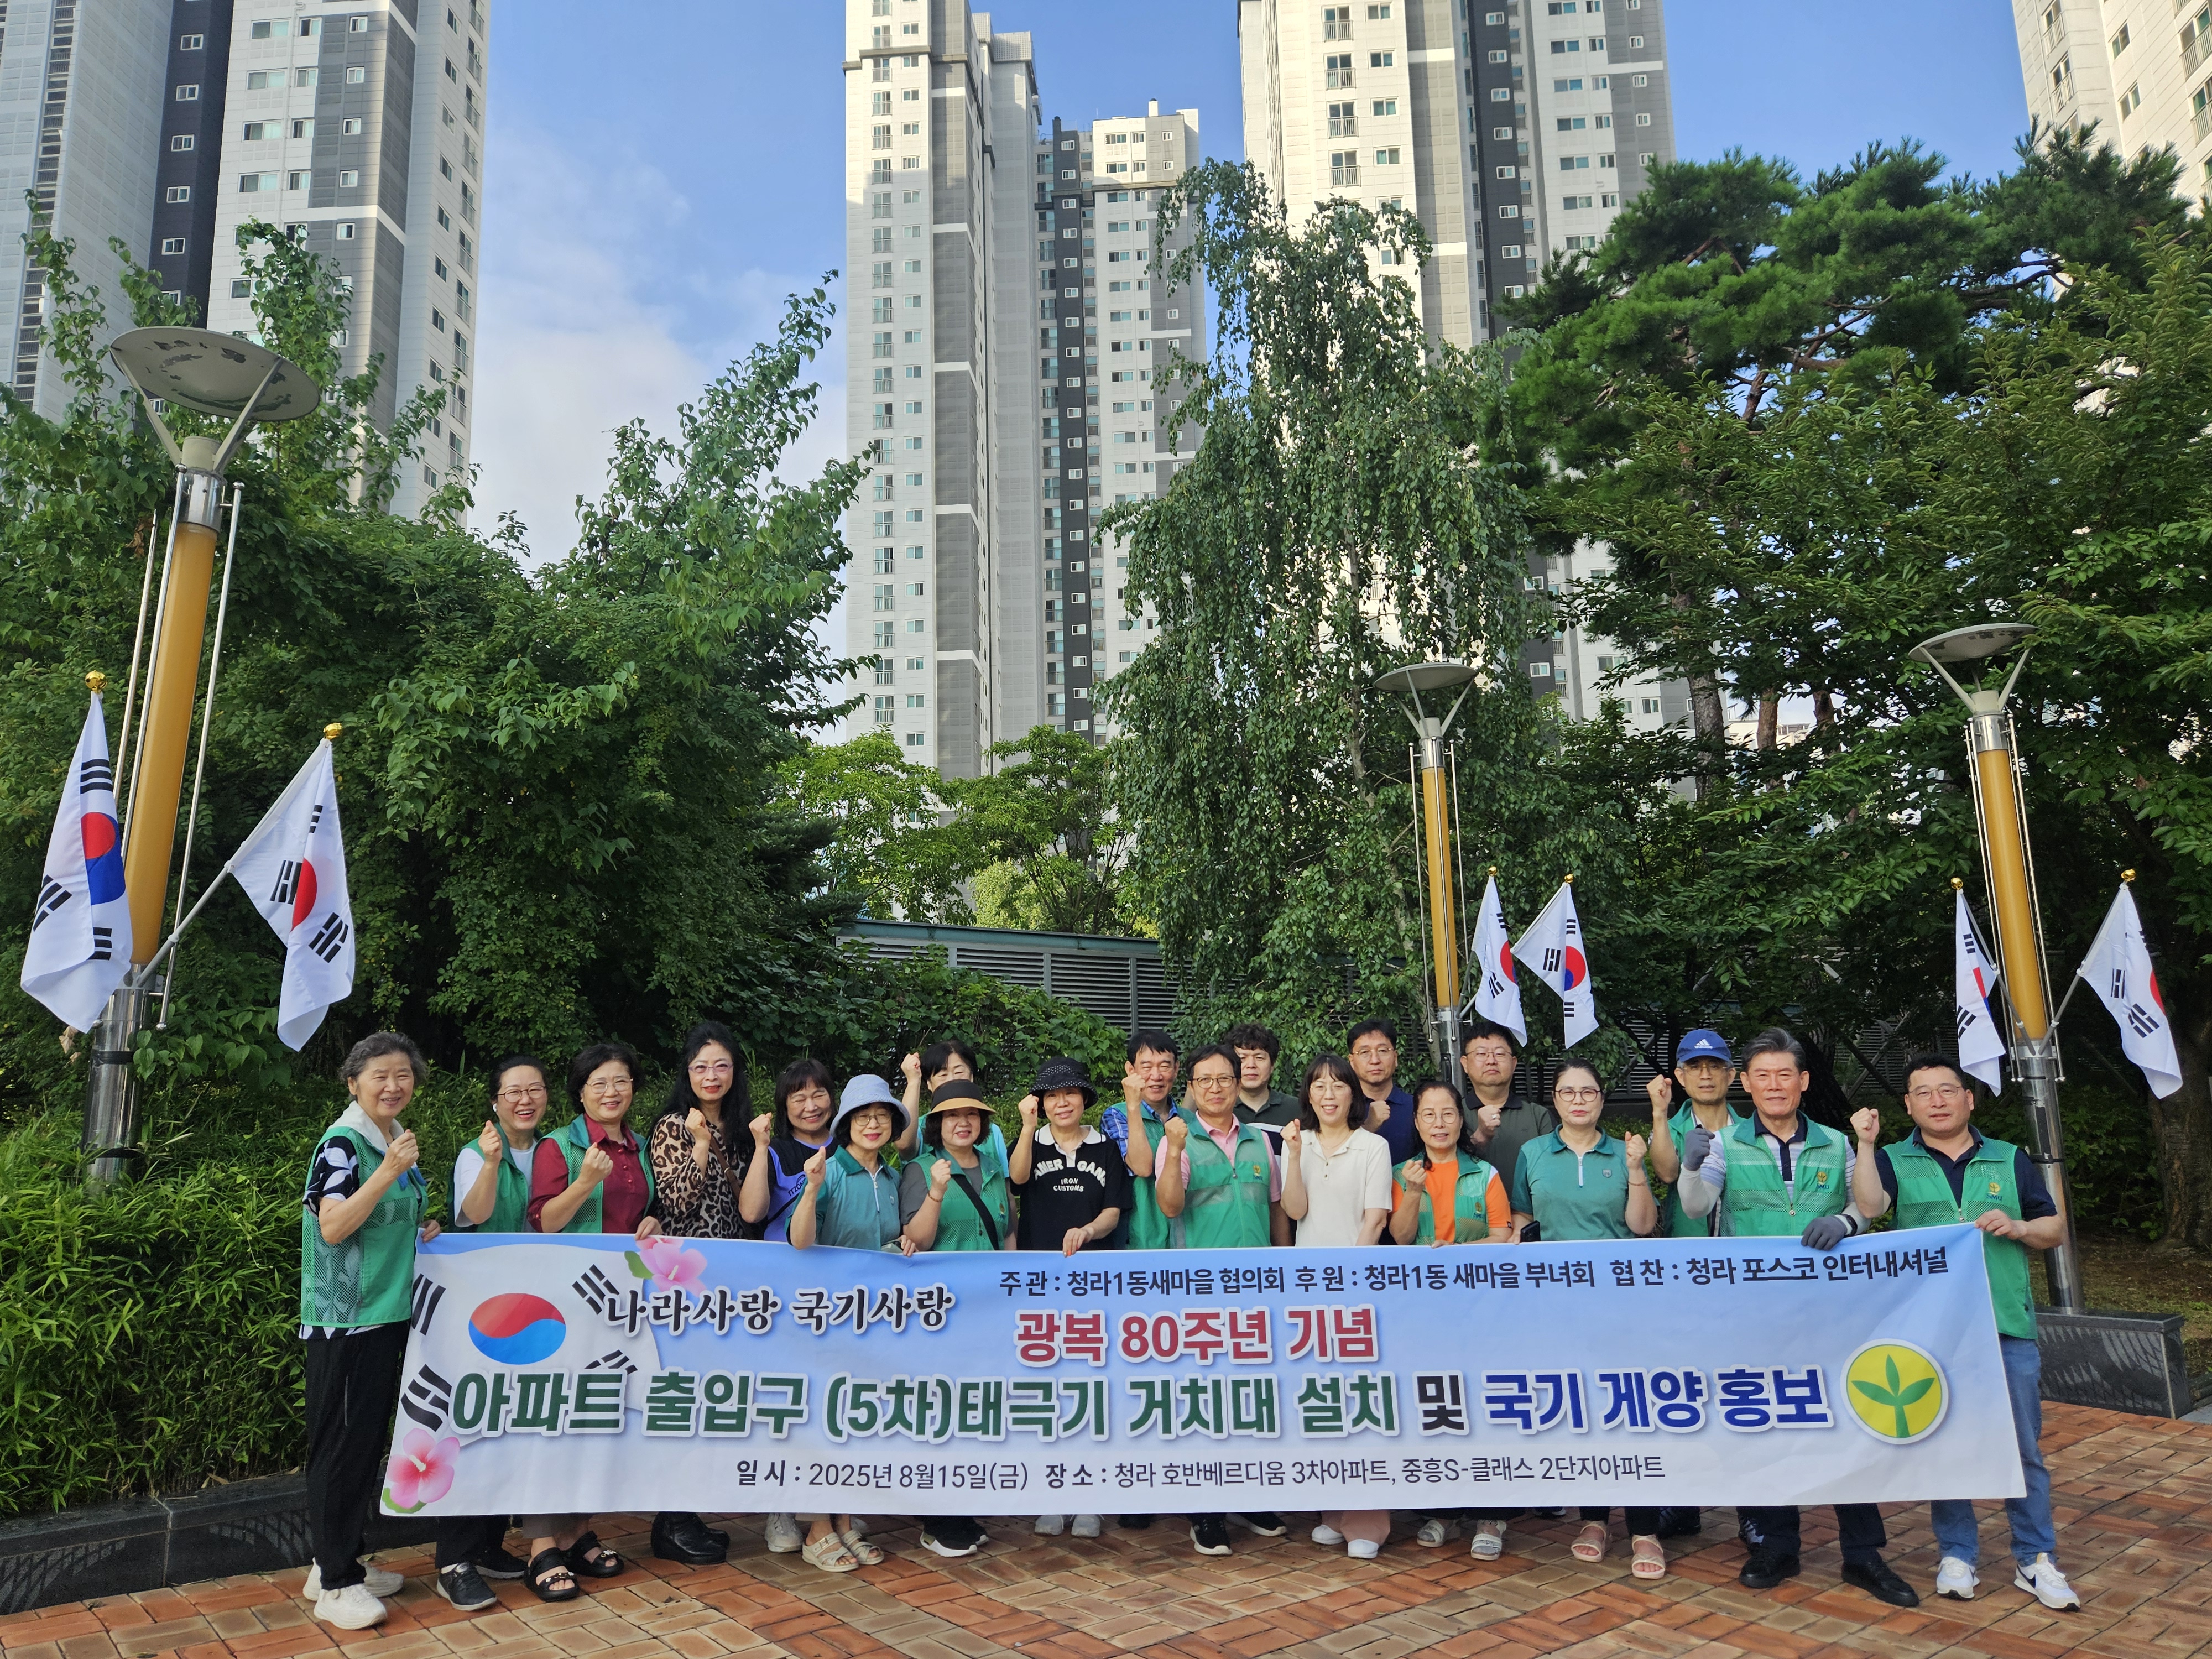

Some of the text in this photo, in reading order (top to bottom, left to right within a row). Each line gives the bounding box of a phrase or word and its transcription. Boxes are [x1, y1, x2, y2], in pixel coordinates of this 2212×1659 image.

[1986, 1193, 2003, 1201] SMU
[1218, 1266, 1285, 1294] 협의회
[1364, 1264, 1448, 1291] 청라1동
[1453, 1262, 1520, 1290] 새마을
[1525, 1260, 1595, 1288] 부녀회
[1686, 1257, 1737, 1285] 청라
[1742, 1257, 1819, 1281] 포스코
[1822, 1246, 1948, 1281] 인터내셔널
[607, 1286, 952, 1333] 나라사랑 국기사랑
[1018, 1308, 1377, 1363] 광복 80주년 기념
[453, 1373, 623, 1432] 아파트
[645, 1371, 804, 1434] 출입구
[1129, 1377, 1276, 1434] 거치대
[1297, 1374, 1395, 1432] 설치
[1417, 1374, 1465, 1431] 및
[1485, 1373, 1584, 1430] 국기
[1599, 1371, 1704, 1428] 게양
[1718, 1368, 1829, 1427] 홍보
[808, 1463, 892, 1489] 2025년
[1114, 1462, 1156, 1488] 청라
[1161, 1460, 1285, 1487] 호반베르디움
[1291, 1459, 1396, 1485] 3차아파트,
[1401, 1456, 1535, 1483] 중흥S-클래스
[1539, 1454, 1666, 1481] 2단지아파트
